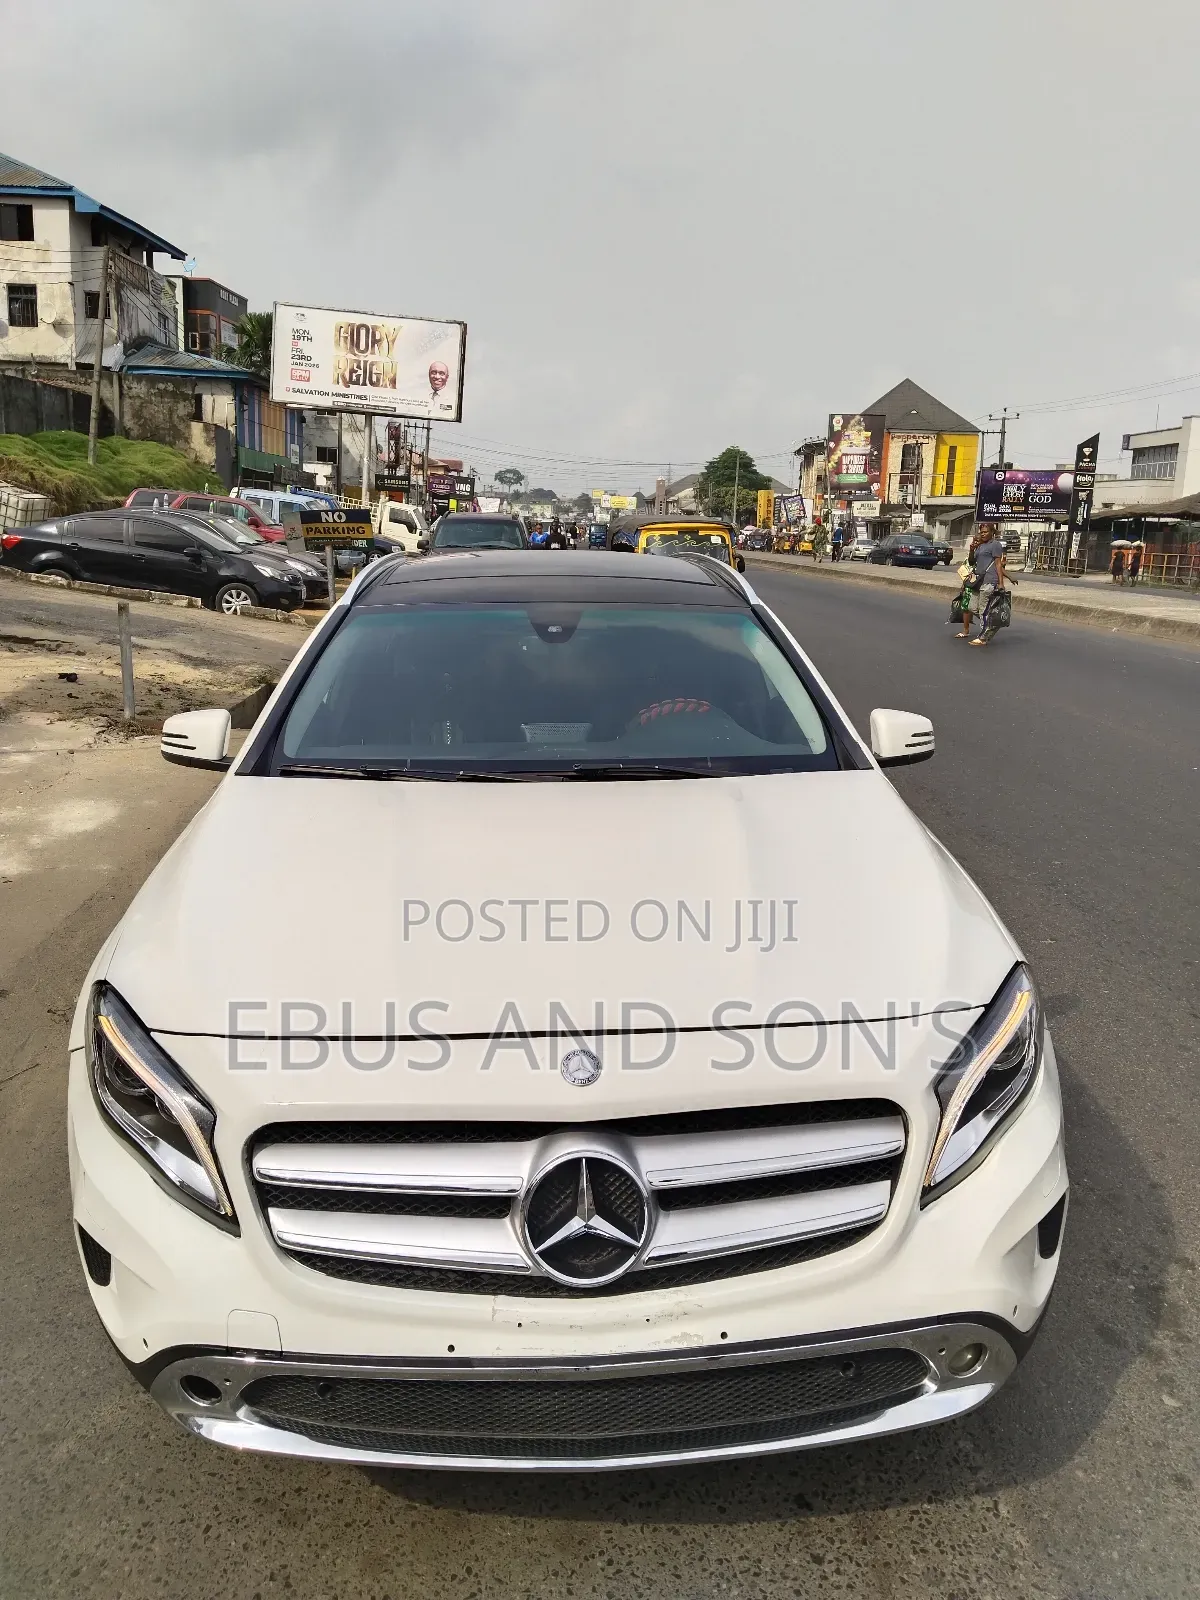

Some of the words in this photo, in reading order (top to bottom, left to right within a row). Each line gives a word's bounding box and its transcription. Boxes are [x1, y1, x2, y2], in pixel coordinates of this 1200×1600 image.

[334, 321, 403, 358] GLORY
[291, 354, 312, 362] 23RD
[332, 358, 398, 389] REIGN
[291, 387, 330, 397] SALVATION
[331, 391, 368, 401] MINISTRIES
[1028, 495, 1052, 504] GOD
[320, 511, 347, 523] NO
[305, 526, 366, 536] PARKING
